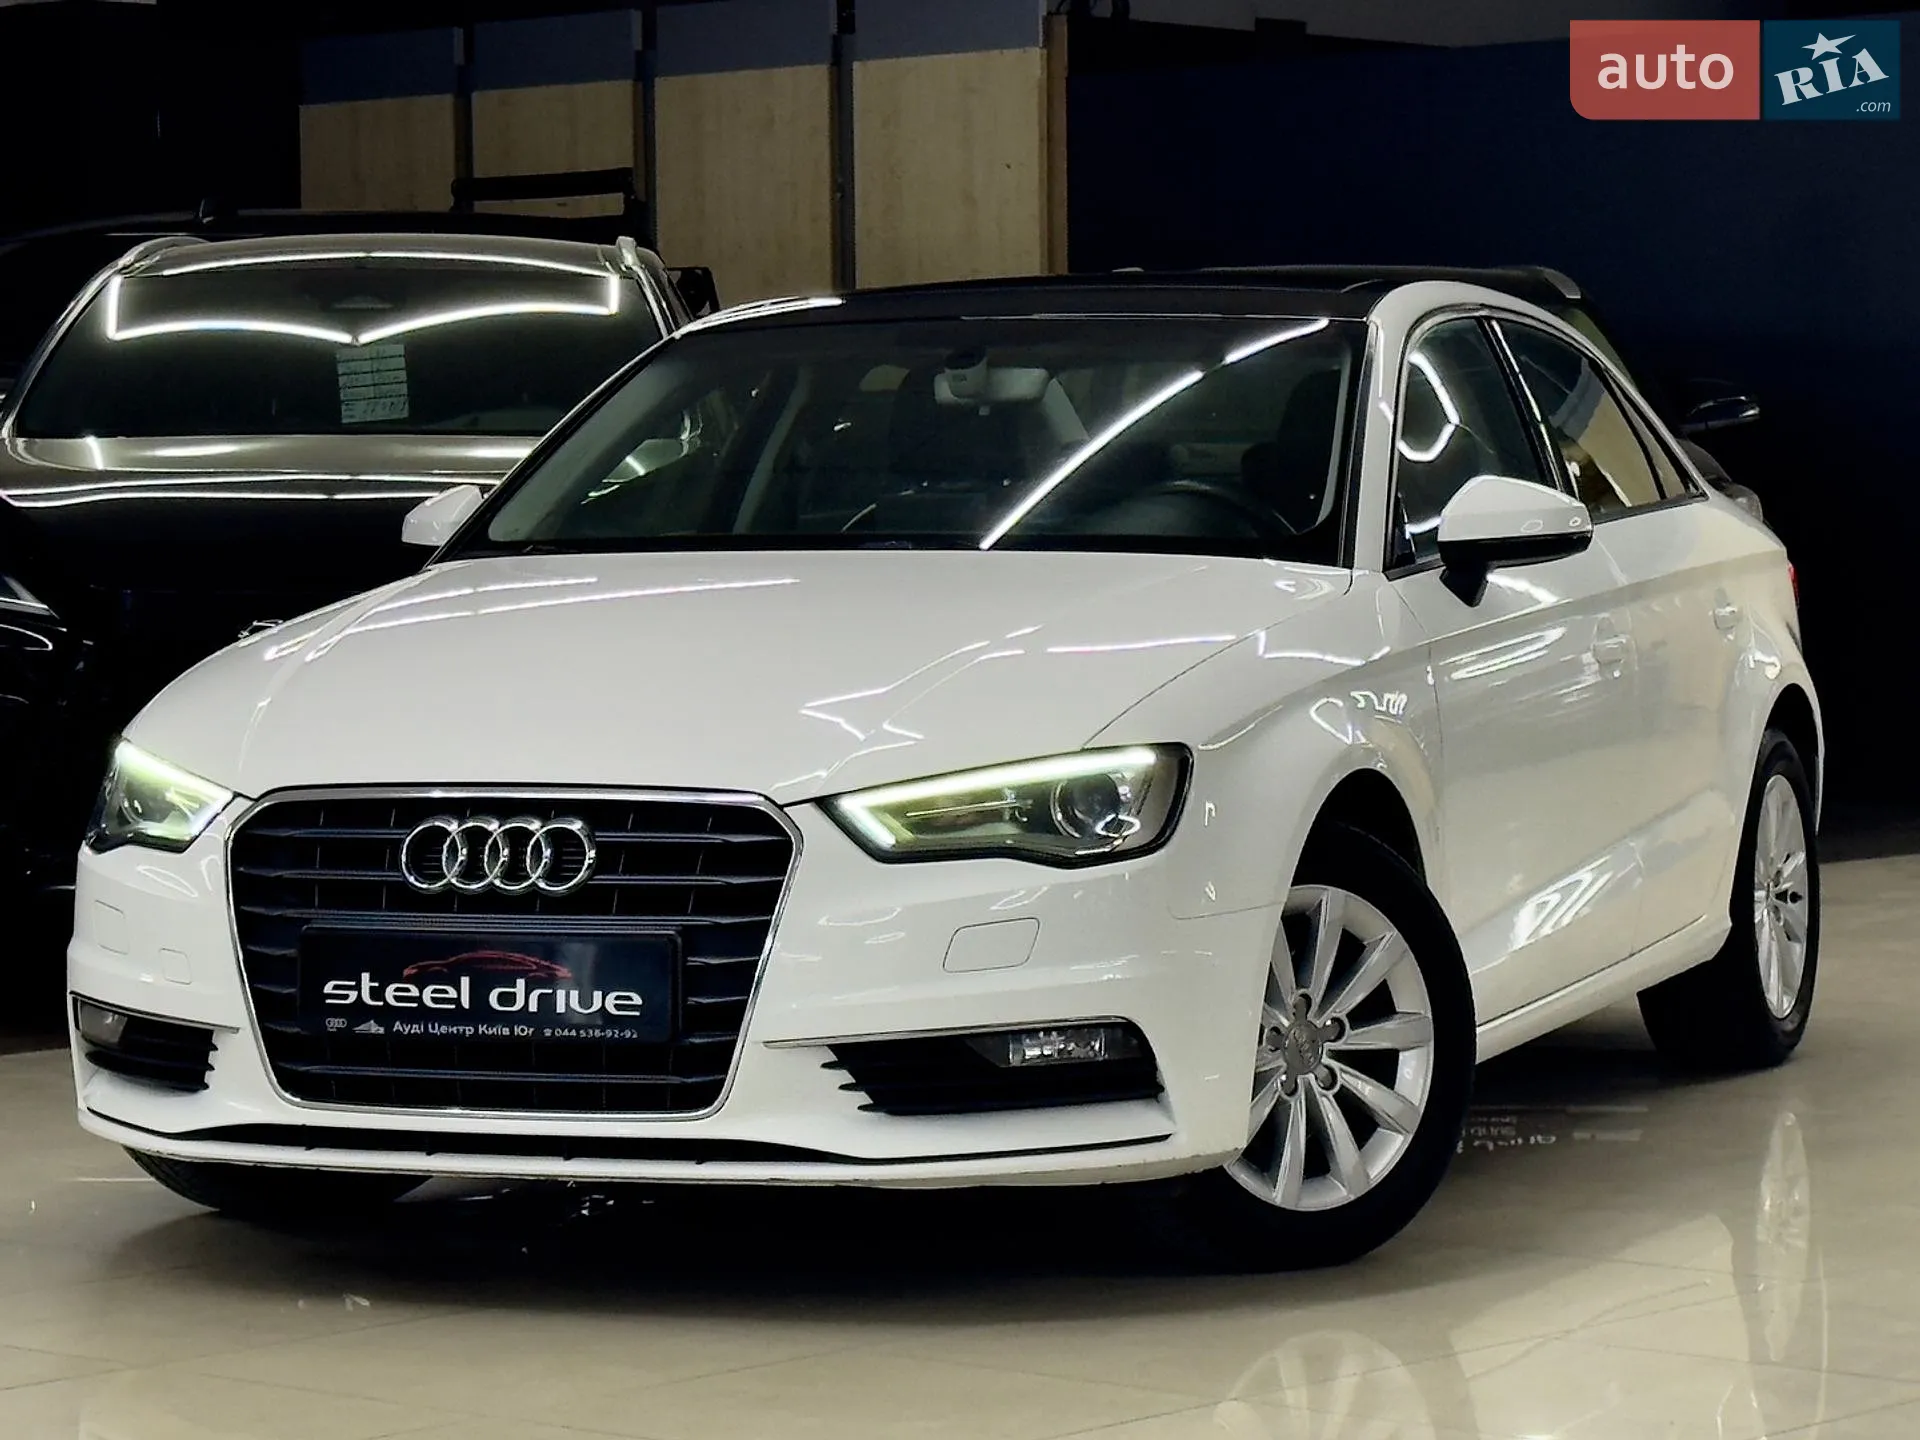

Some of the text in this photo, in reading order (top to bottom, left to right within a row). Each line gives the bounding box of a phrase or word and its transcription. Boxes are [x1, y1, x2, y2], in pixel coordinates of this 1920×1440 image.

[323, 972, 643, 1016] steel drive
[393, 1021, 424, 1035] Ауді
[428, 1022, 475, 1037] Центр
[478, 1024, 510, 1036] Київ
[514, 1025, 535, 1037] Юг
[554, 1028, 577, 1037] 044
